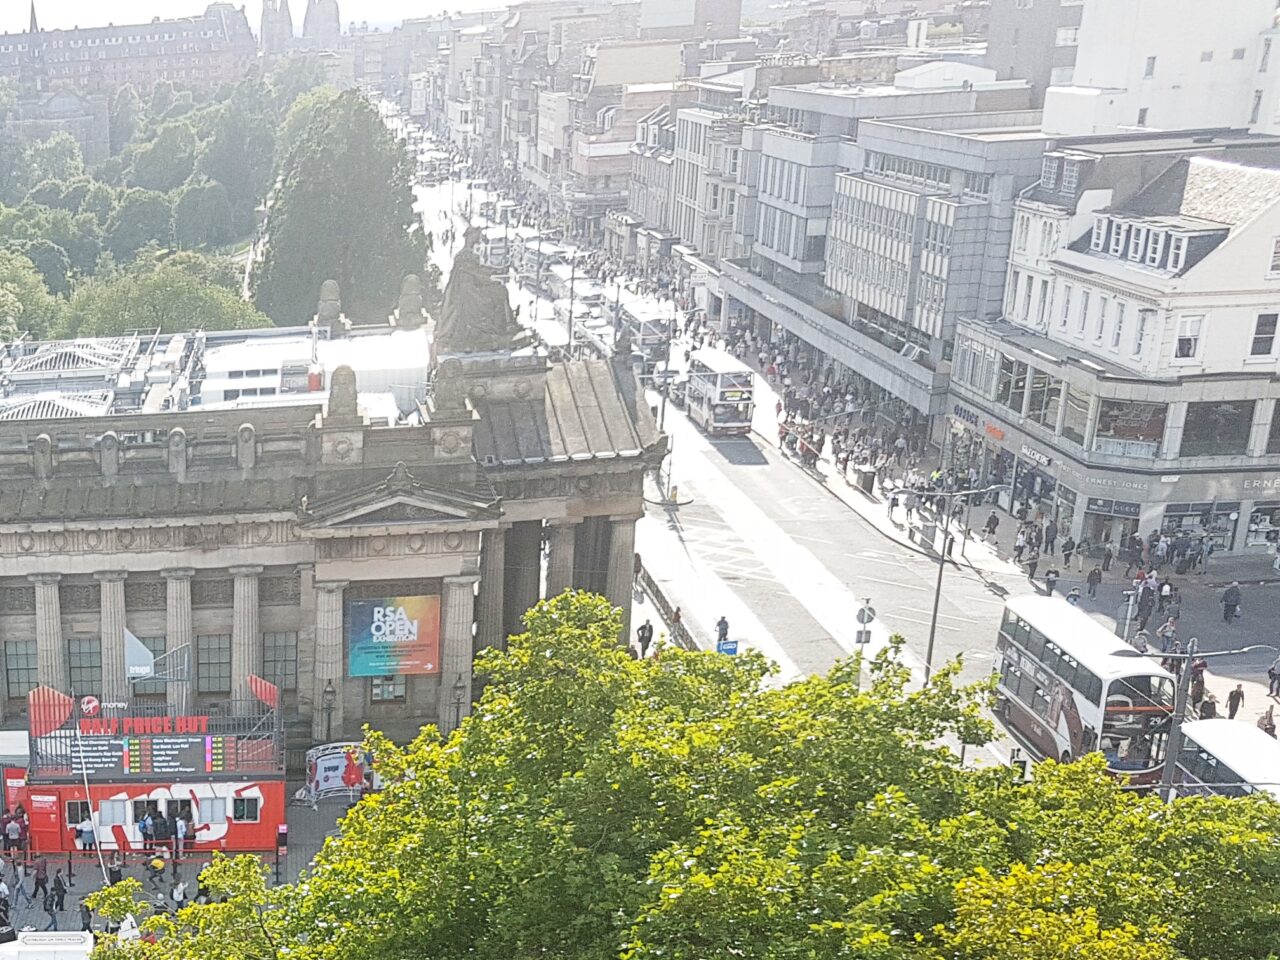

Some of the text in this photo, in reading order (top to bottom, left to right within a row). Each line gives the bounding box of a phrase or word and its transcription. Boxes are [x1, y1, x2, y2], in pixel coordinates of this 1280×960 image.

[1021, 444, 1050, 467] SKECHERS
[1086, 476, 1148, 490] ERNEST JONES
[1114, 505, 1139, 514] GUCCI
[373, 606, 408, 622] RSA
[370, 619, 418, 636] OPEN
[373, 634, 418, 643] EXHIBITION
[101, 701, 129, 711] money
[80, 715, 209, 736] HALF PRICE HUT
